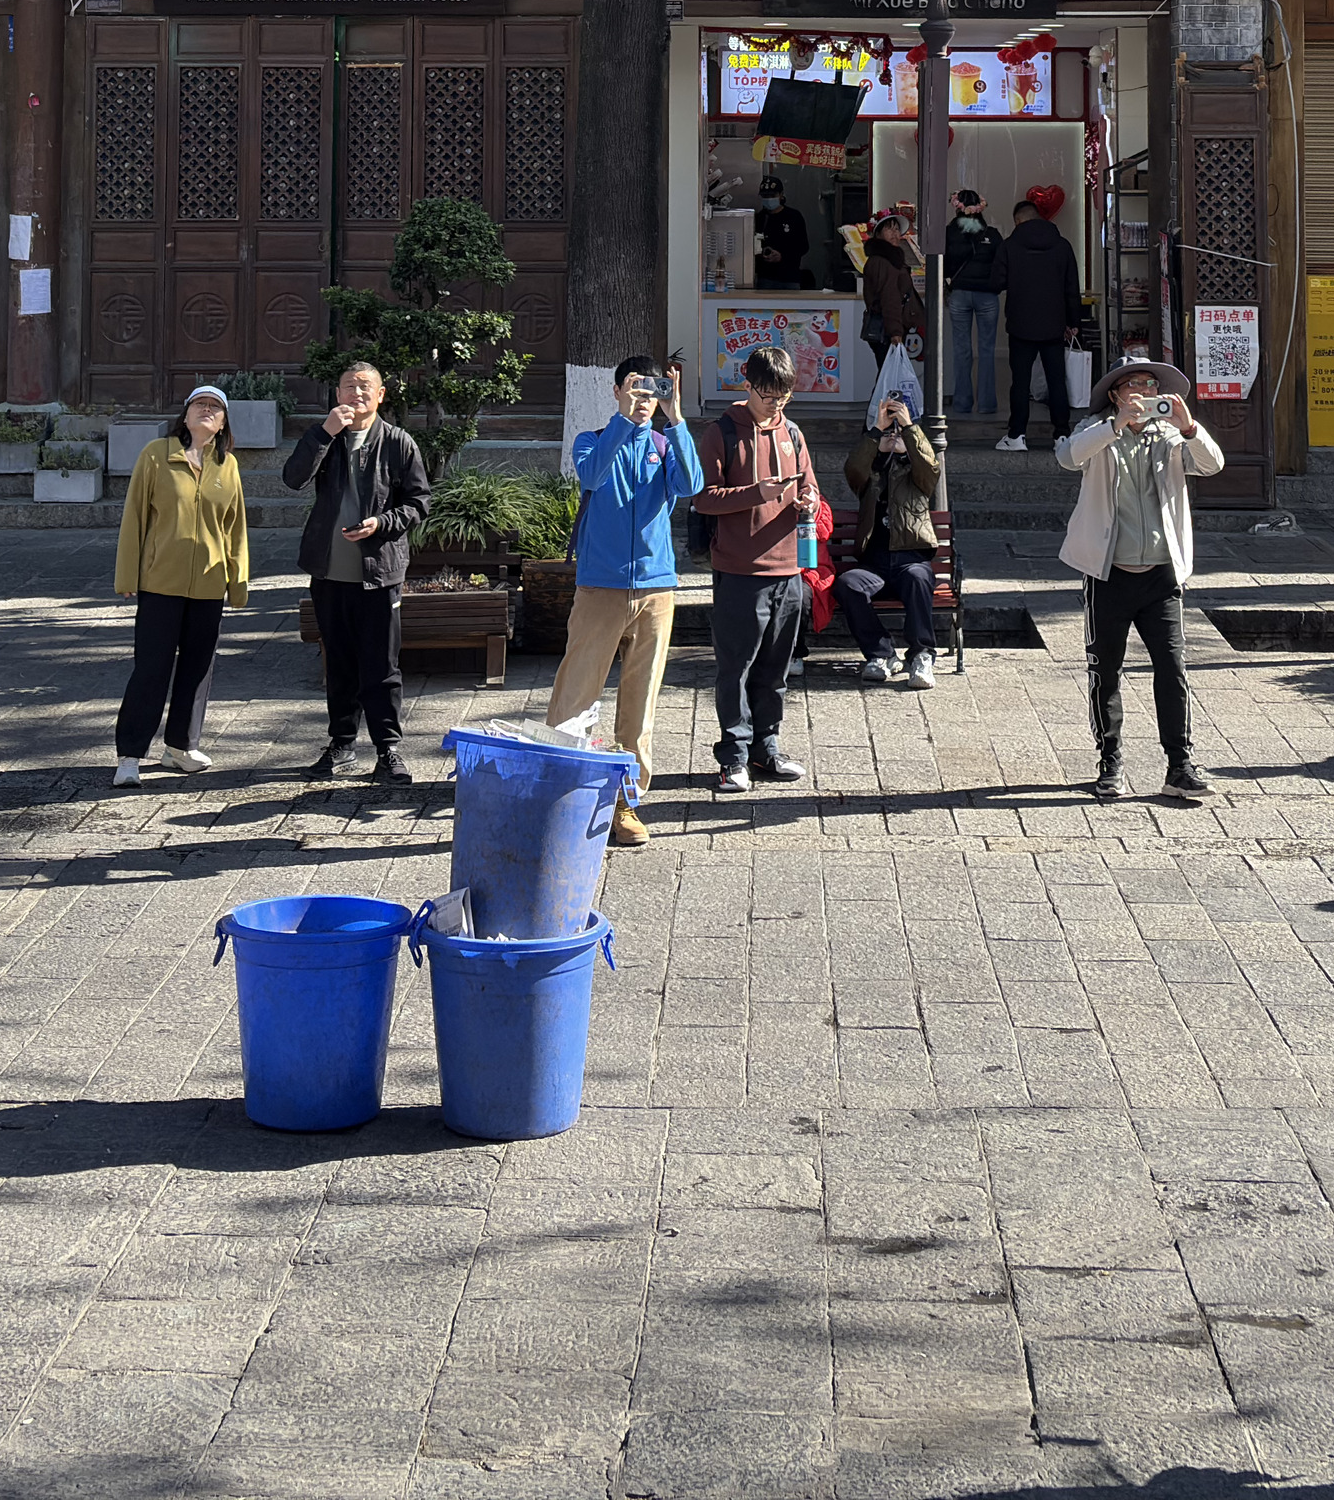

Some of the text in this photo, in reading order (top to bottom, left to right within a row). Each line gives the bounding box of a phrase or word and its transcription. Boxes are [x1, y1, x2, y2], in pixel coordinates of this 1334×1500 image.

[1200, 309, 1255, 323] 扫码点单
[720, 316, 772, 335] 蜜雪在手
[1212, 324, 1243, 334] 更快哦
[724, 332, 773, 354] 快乐久久
